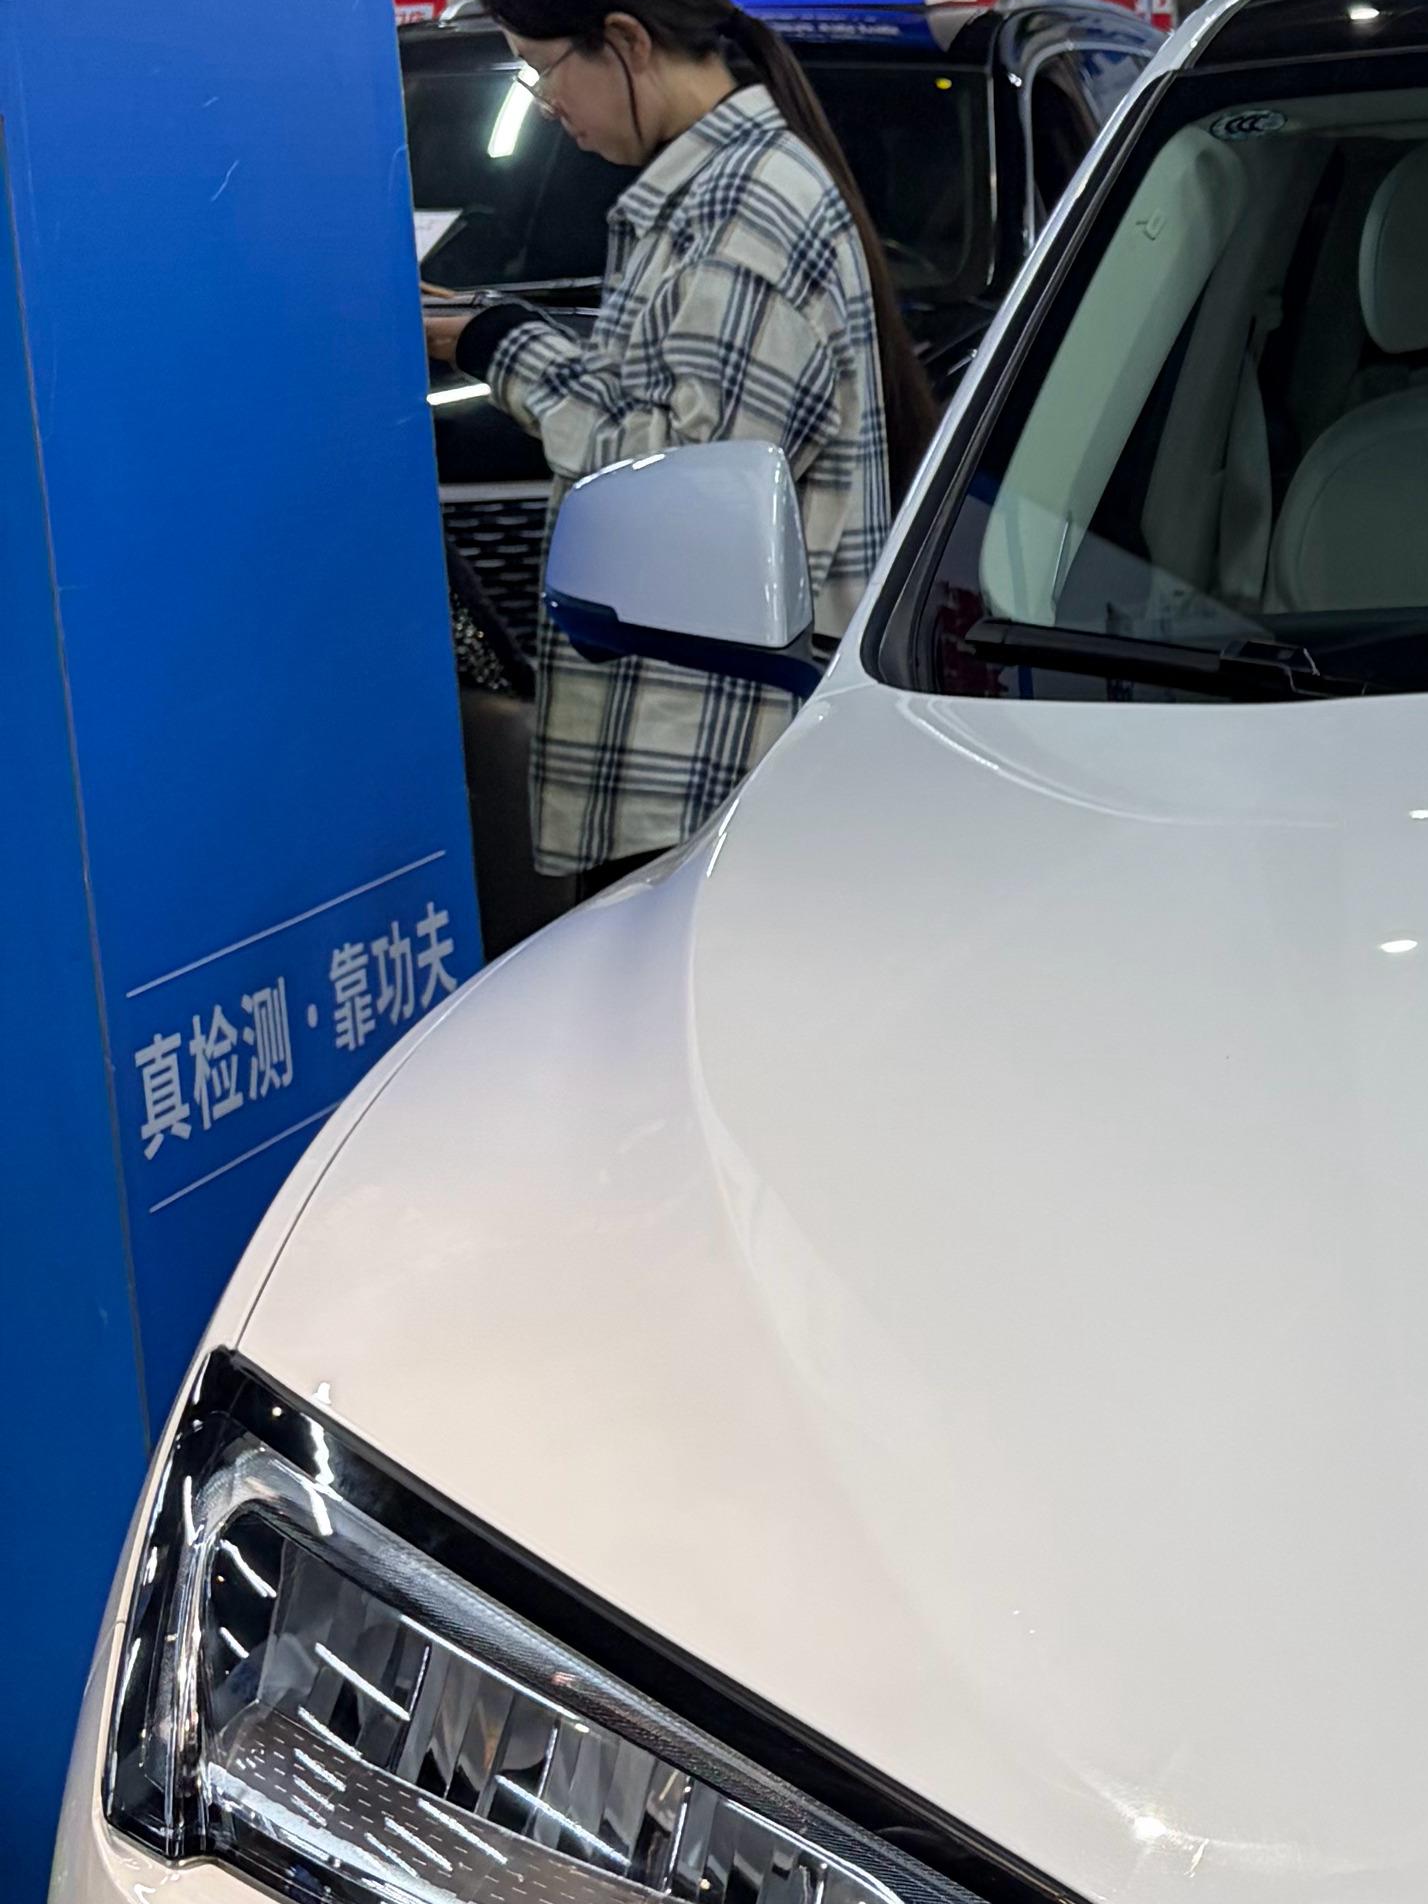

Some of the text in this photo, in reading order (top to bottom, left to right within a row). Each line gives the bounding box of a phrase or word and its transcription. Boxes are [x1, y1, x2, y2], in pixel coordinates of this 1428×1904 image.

[134, 901, 457, 1161] 真检测·靠功夫
